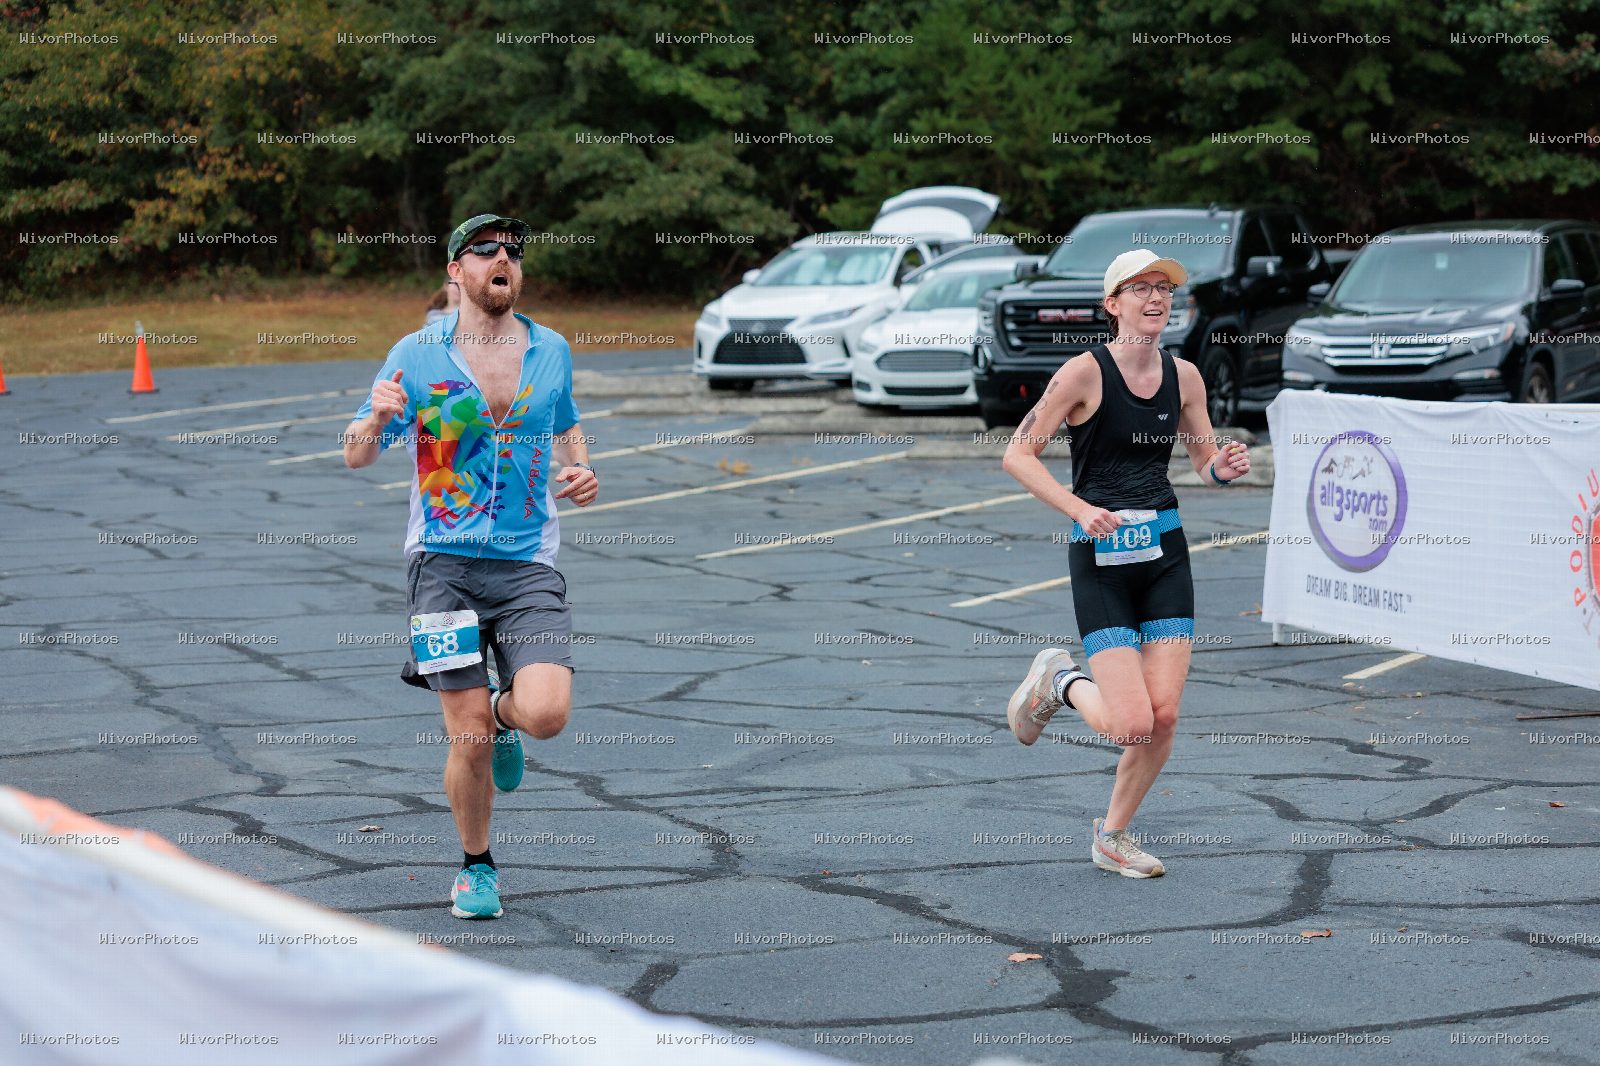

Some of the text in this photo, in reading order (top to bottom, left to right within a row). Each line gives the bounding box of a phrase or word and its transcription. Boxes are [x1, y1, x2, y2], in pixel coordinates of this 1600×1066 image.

[1037, 308, 1095, 321] GMC
[1320, 480, 1388, 522] all3sports
[1306, 574, 1332, 599] DREAM
[1353, 583, 1380, 609] DREAM
[427, 632, 459, 657] 68
